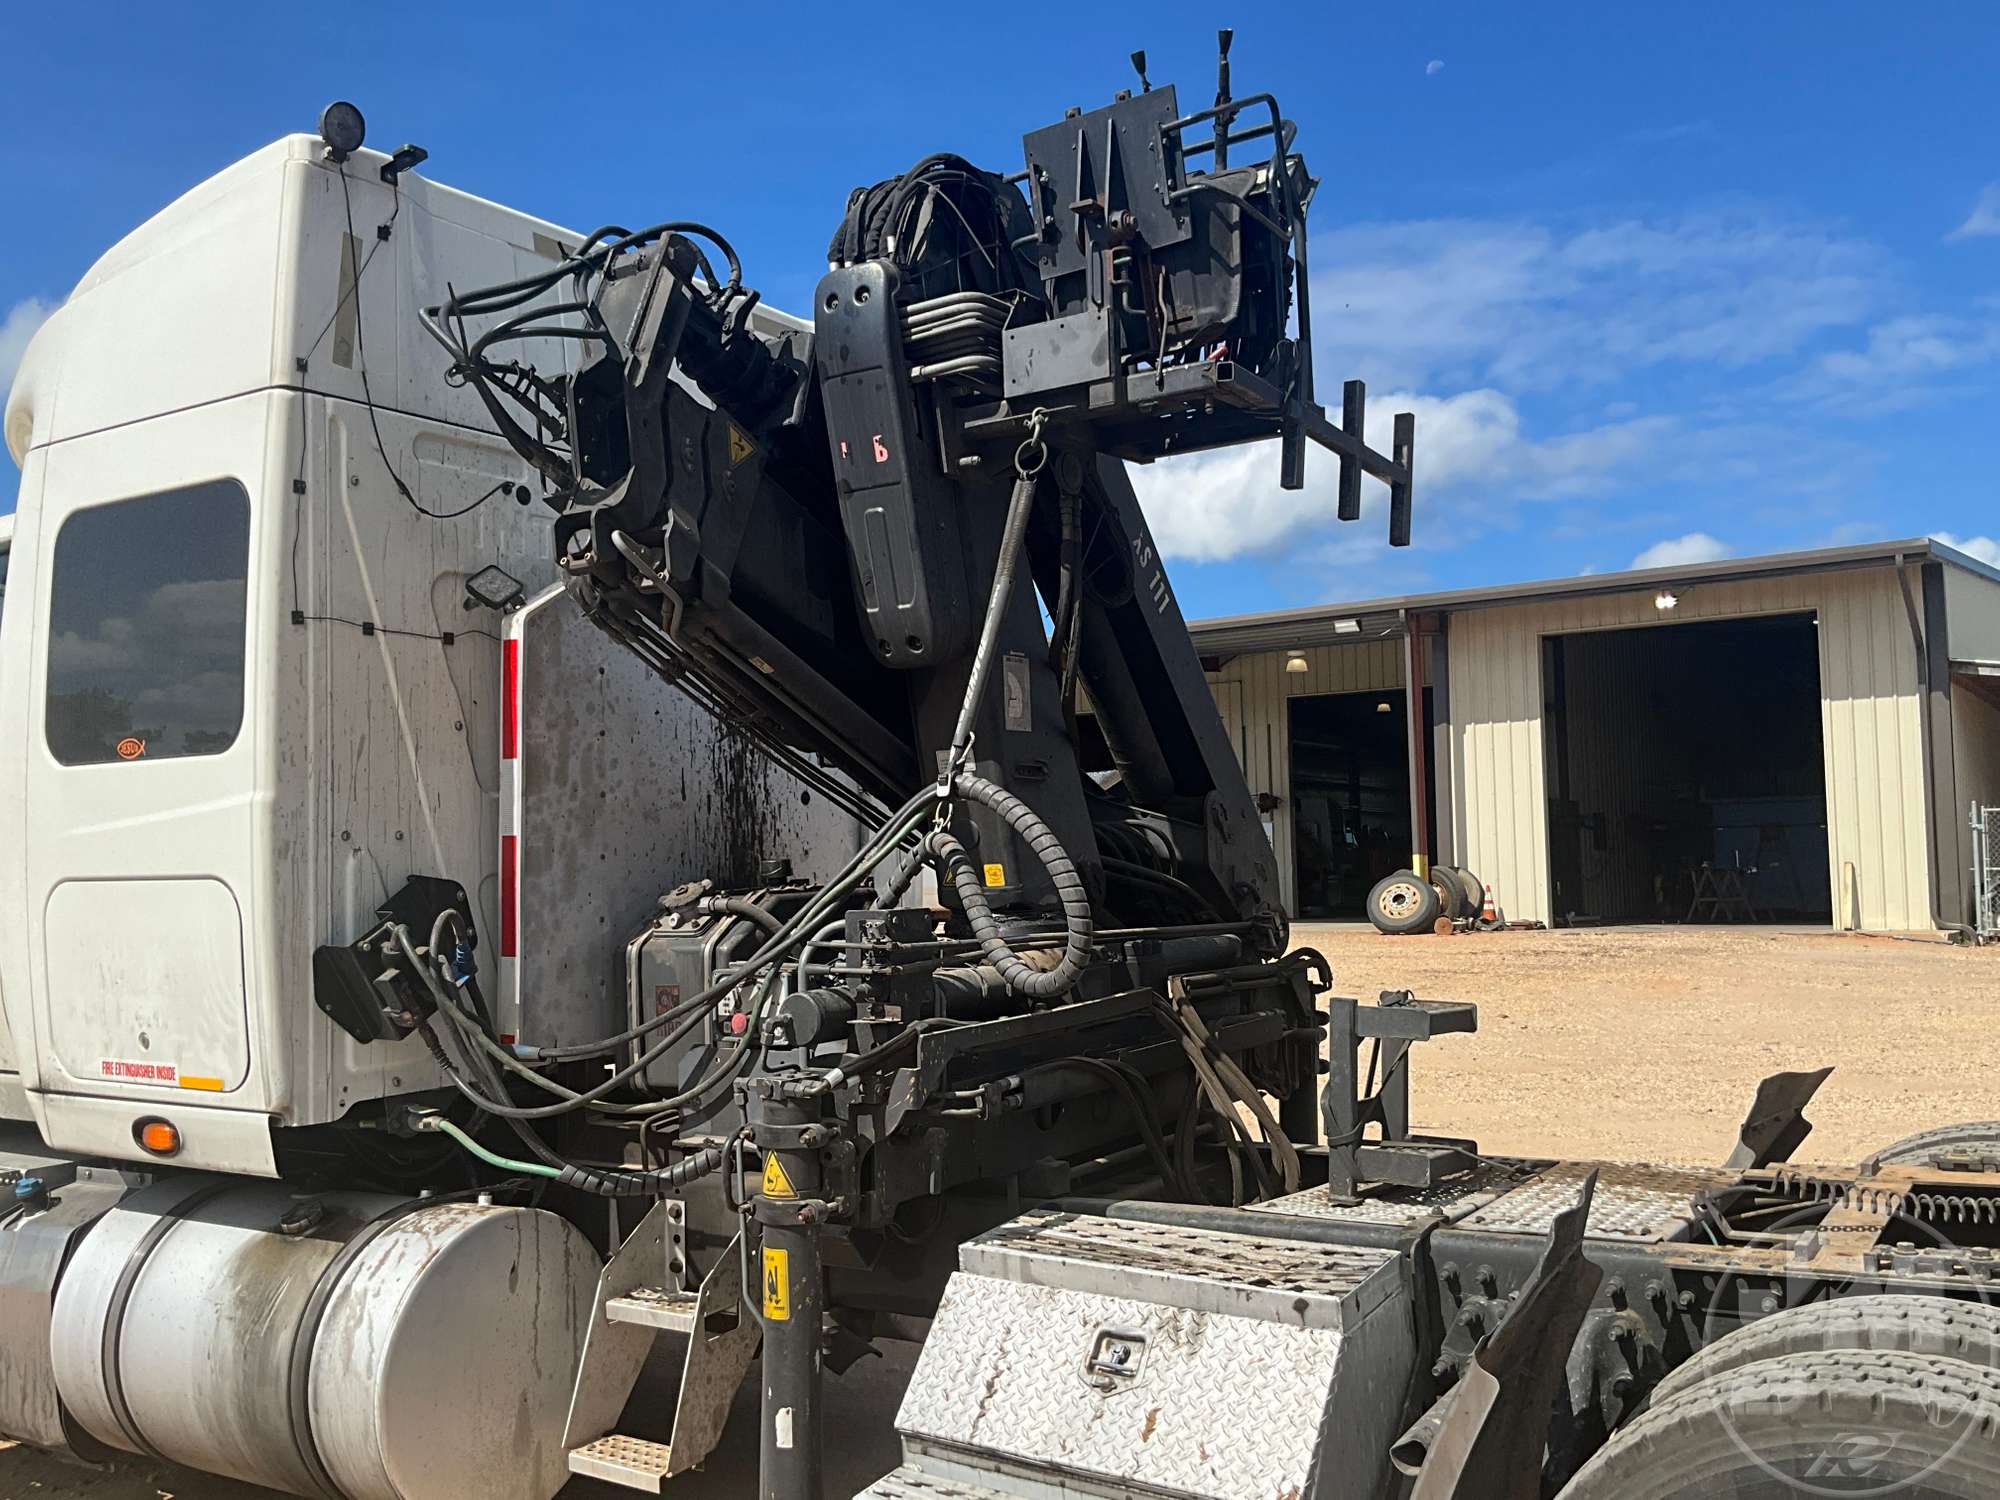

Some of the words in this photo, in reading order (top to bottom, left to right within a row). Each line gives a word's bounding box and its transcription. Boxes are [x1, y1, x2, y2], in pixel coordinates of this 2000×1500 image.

[102, 1061, 114, 1075] FIRE
[115, 1062, 156, 1079] EXTINGUISHER
[156, 1066, 176, 1081] INSIDE
